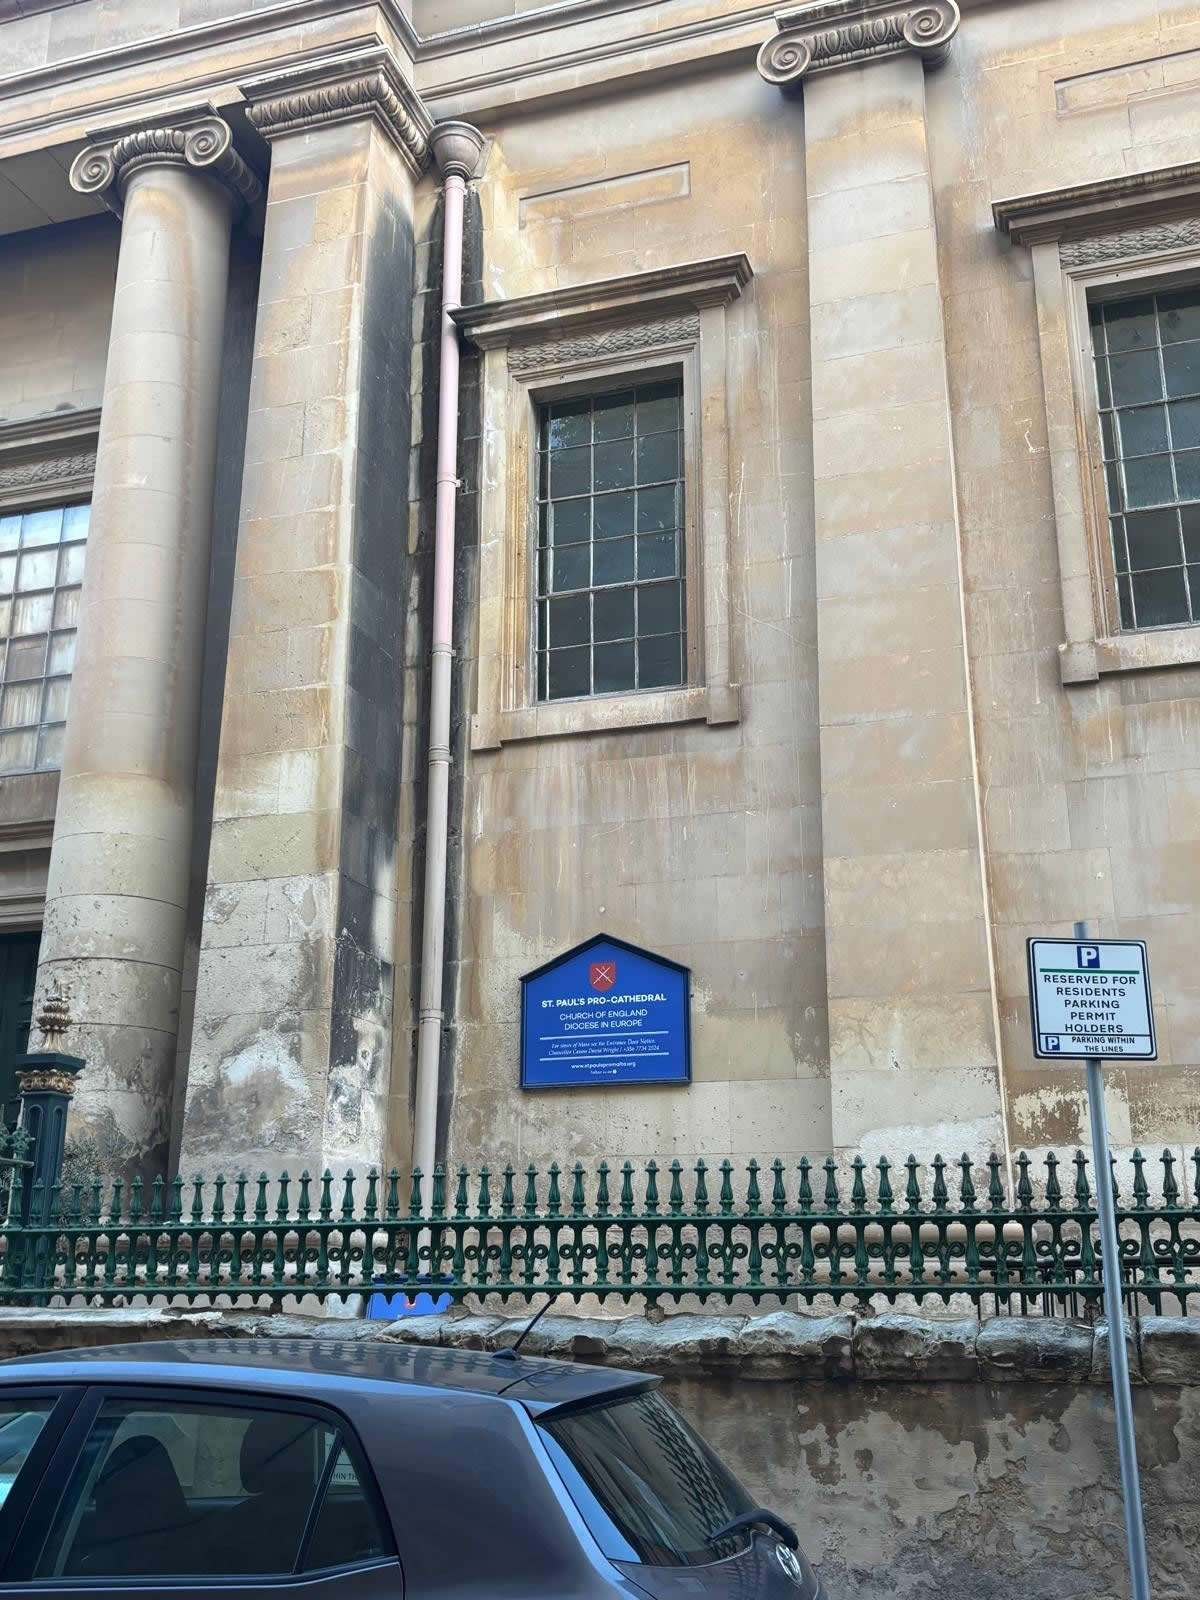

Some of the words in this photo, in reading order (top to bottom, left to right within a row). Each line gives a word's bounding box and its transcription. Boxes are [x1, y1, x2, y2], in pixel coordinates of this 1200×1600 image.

[1080, 947, 1098, 967] P
[1044, 974, 1108, 985] RESERVED
[1112, 976, 1137, 985] FOR
[1056, 987, 1126, 997] RESIDENTS
[541, 1000, 555, 1008] ST.
[556, 998, 586, 1007] PAUL'S
[587, 993, 667, 1005] PRO-CATHEDRAL
[1064, 999, 1120, 1009] PARKING
[559, 1012, 594, 1021] CHURCH
[595, 1011, 607, 1019] OF
[608, 1008, 648, 1018] ENGLAND
[1070, 1011, 1116, 1021] PERMIT
[564, 1021, 599, 1031] DIOCESE
[610, 1019, 643, 1028] EUROPE
[1065, 1023, 1124, 1033] HOLDERS
[1047, 1037, 1059, 1050] P
[1072, 1036, 1106, 1044] PARKING
[1108, 1036, 1135, 1044] WITHIN
[1101, 1045, 1124, 1053] LINES
